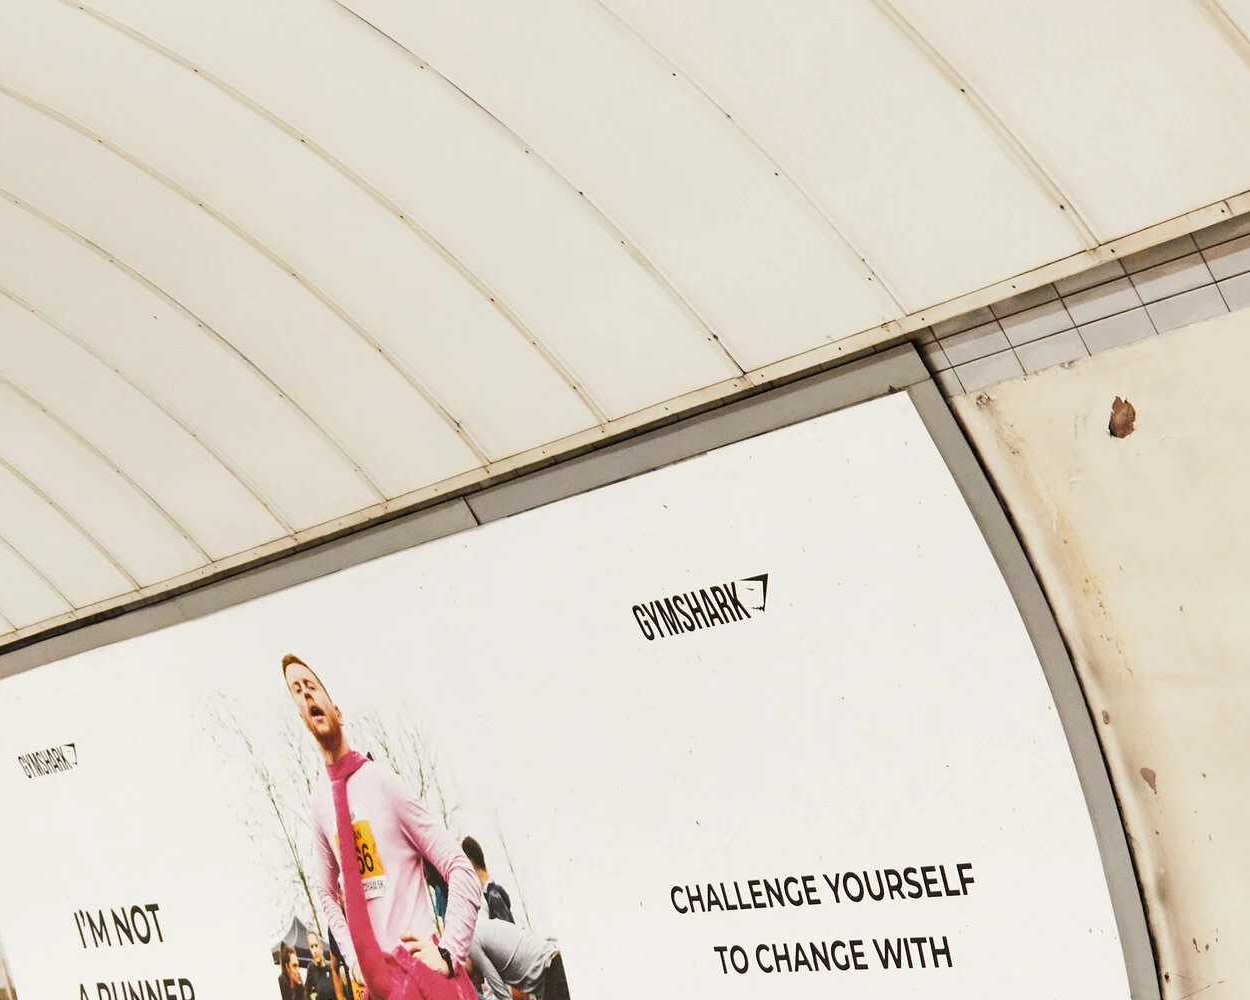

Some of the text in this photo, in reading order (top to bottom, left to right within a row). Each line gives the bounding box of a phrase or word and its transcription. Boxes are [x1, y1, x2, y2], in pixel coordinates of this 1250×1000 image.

[631, 581, 752, 641] GYMSHARK
[18, 745, 74, 779] GYMSHARK
[670, 862, 976, 914] CHALLENGE YOURSELF
[74, 902, 164, 948] I'M NOT
[713, 935, 954, 974] TO CHANGE WITH
